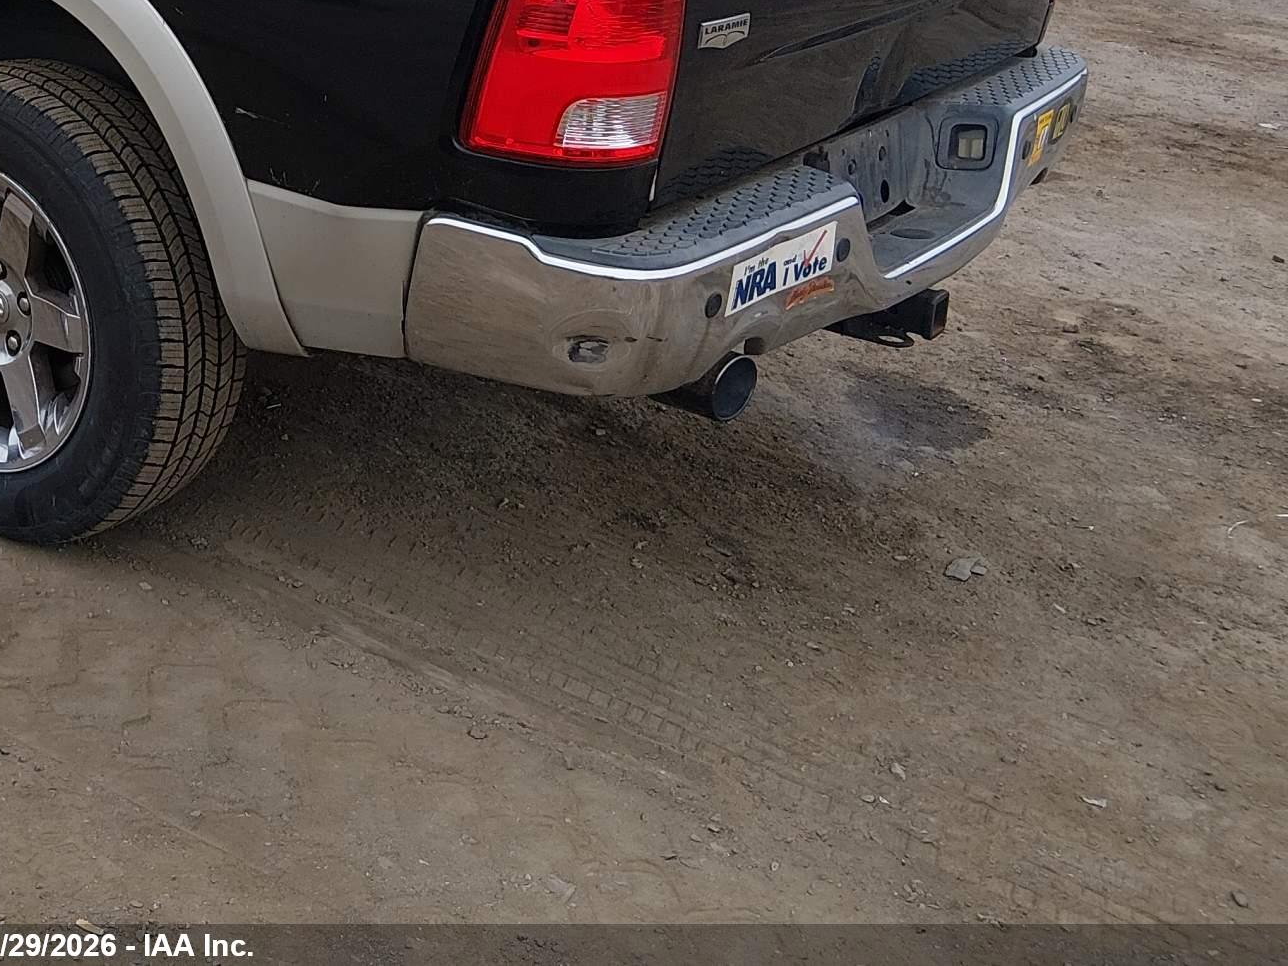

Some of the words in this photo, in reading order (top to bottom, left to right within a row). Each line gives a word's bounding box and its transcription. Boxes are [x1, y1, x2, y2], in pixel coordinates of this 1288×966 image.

[705, 18, 749, 35] LARAMIE
[784, 253, 798, 266] and
[732, 261, 776, 311] NRA
[794, 256, 828, 282] Vote
